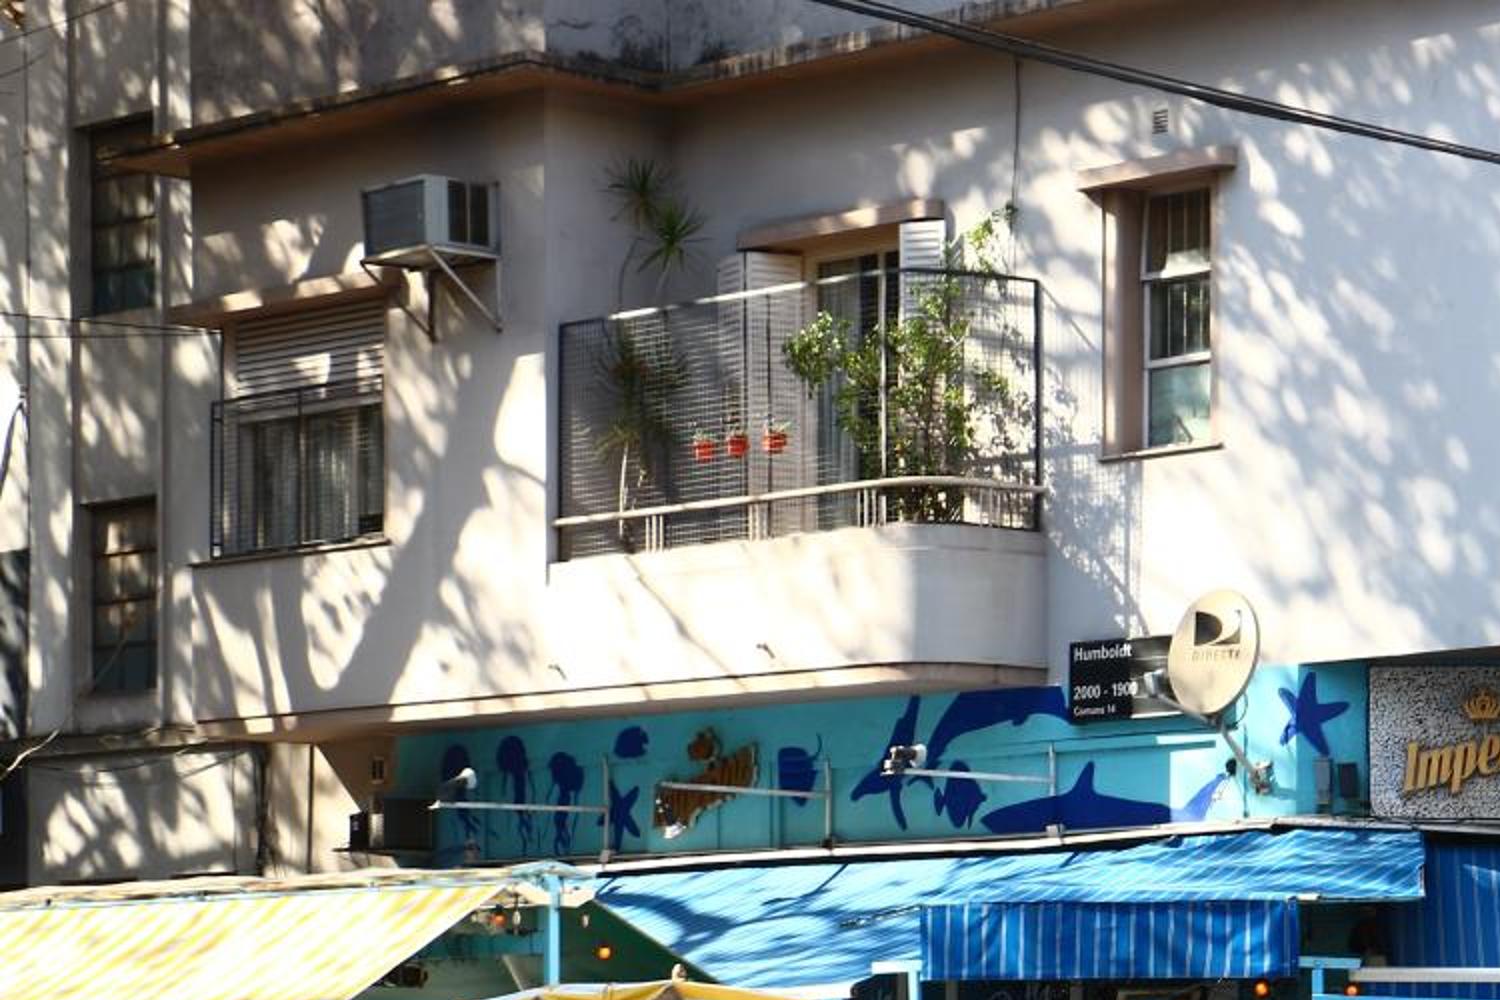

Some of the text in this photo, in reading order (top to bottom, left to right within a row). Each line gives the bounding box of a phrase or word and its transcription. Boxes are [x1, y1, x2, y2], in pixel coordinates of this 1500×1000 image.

[1073, 643, 1133, 662] Humboldt
[1072, 684, 1102, 701] 2000
[1111, 680, 1138, 698] 1900
